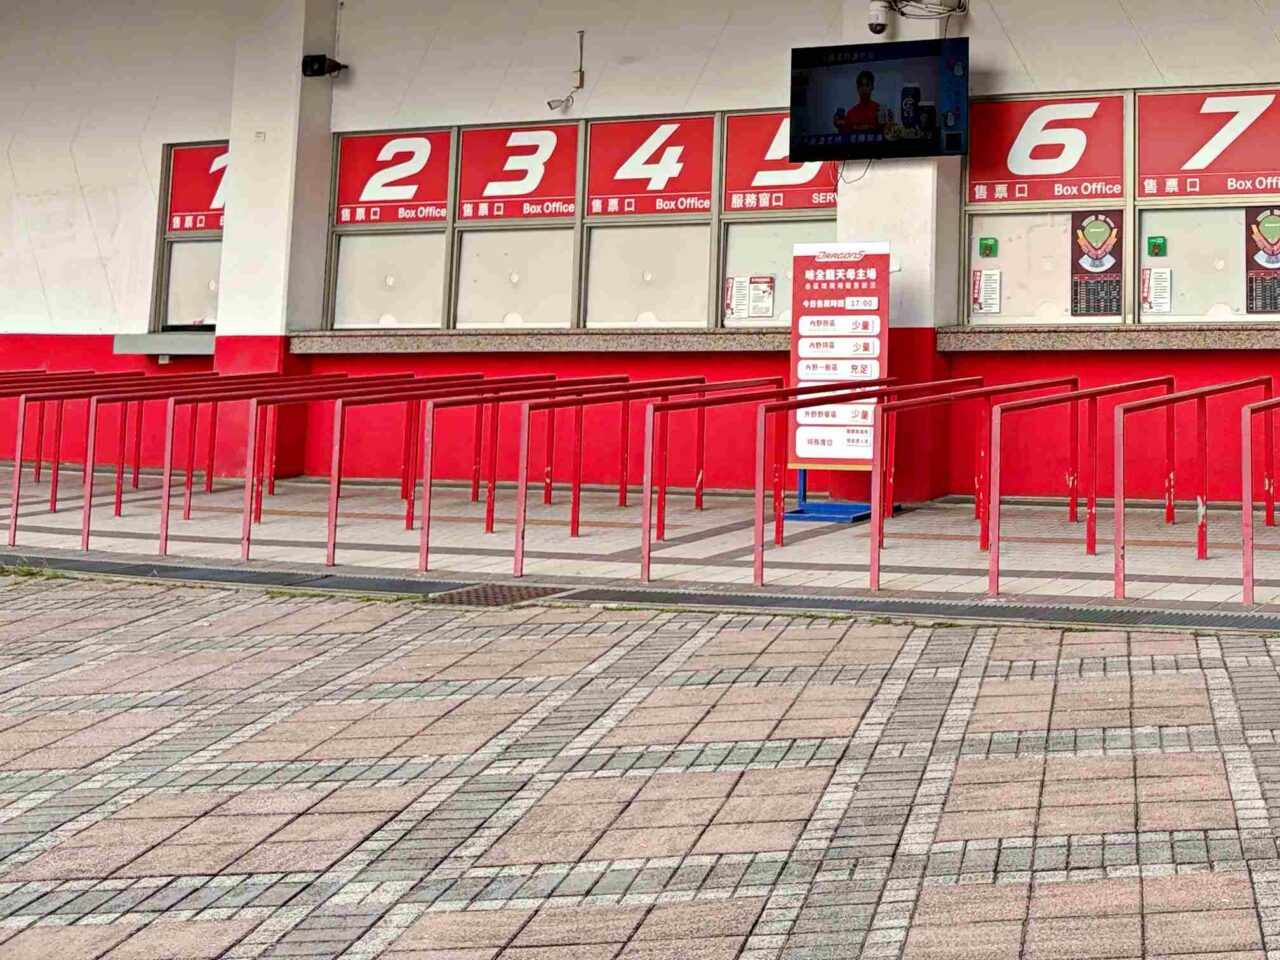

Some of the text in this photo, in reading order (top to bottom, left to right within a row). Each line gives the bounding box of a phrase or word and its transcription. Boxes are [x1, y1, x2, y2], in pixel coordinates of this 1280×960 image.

[1007, 102, 1100, 175] 6
[1180, 94, 1276, 170] 7
[482, 130, 557, 196] 3
[614, 123, 684, 191] 4
[359, 137, 431, 202] 2
[1054, 181, 1122, 196] Box Office
[1143, 178, 1200, 194] 售票口
[1227, 177, 1253, 190] Box
[974, 184, 1029, 200] 售票口
[523, 201, 575, 214] Box Office
[591, 198, 635, 213] 售票口
[656, 197, 711, 210] Box Office
[731, 193, 784, 208] 服務窗口
[341, 207, 380, 222] 售票口
[398, 206, 447, 218] Box Office
[462, 202, 504, 217] 售票口
